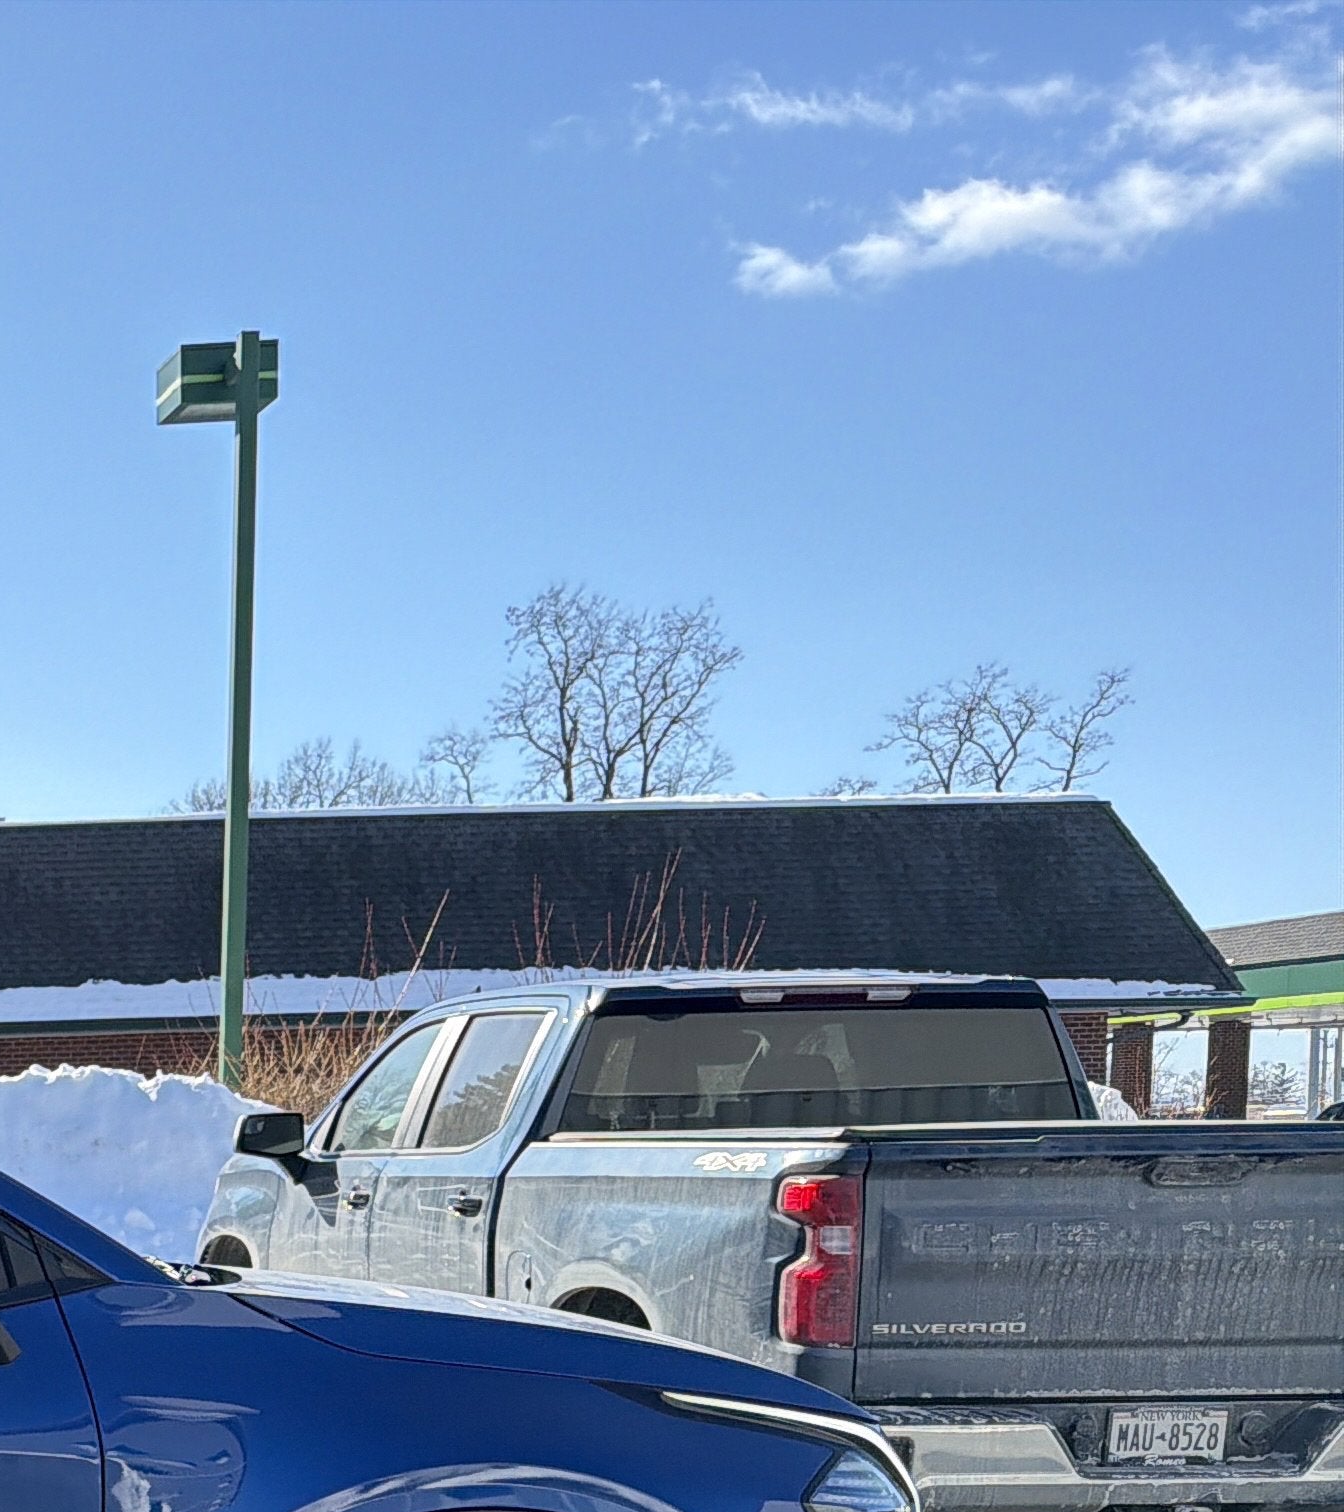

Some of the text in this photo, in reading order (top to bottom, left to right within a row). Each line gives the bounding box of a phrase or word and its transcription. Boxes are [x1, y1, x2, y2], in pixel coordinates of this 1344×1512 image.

[871, 1321, 1027, 1335] SILVERADO
[1140, 1411, 1201, 1422] NEW YORK
